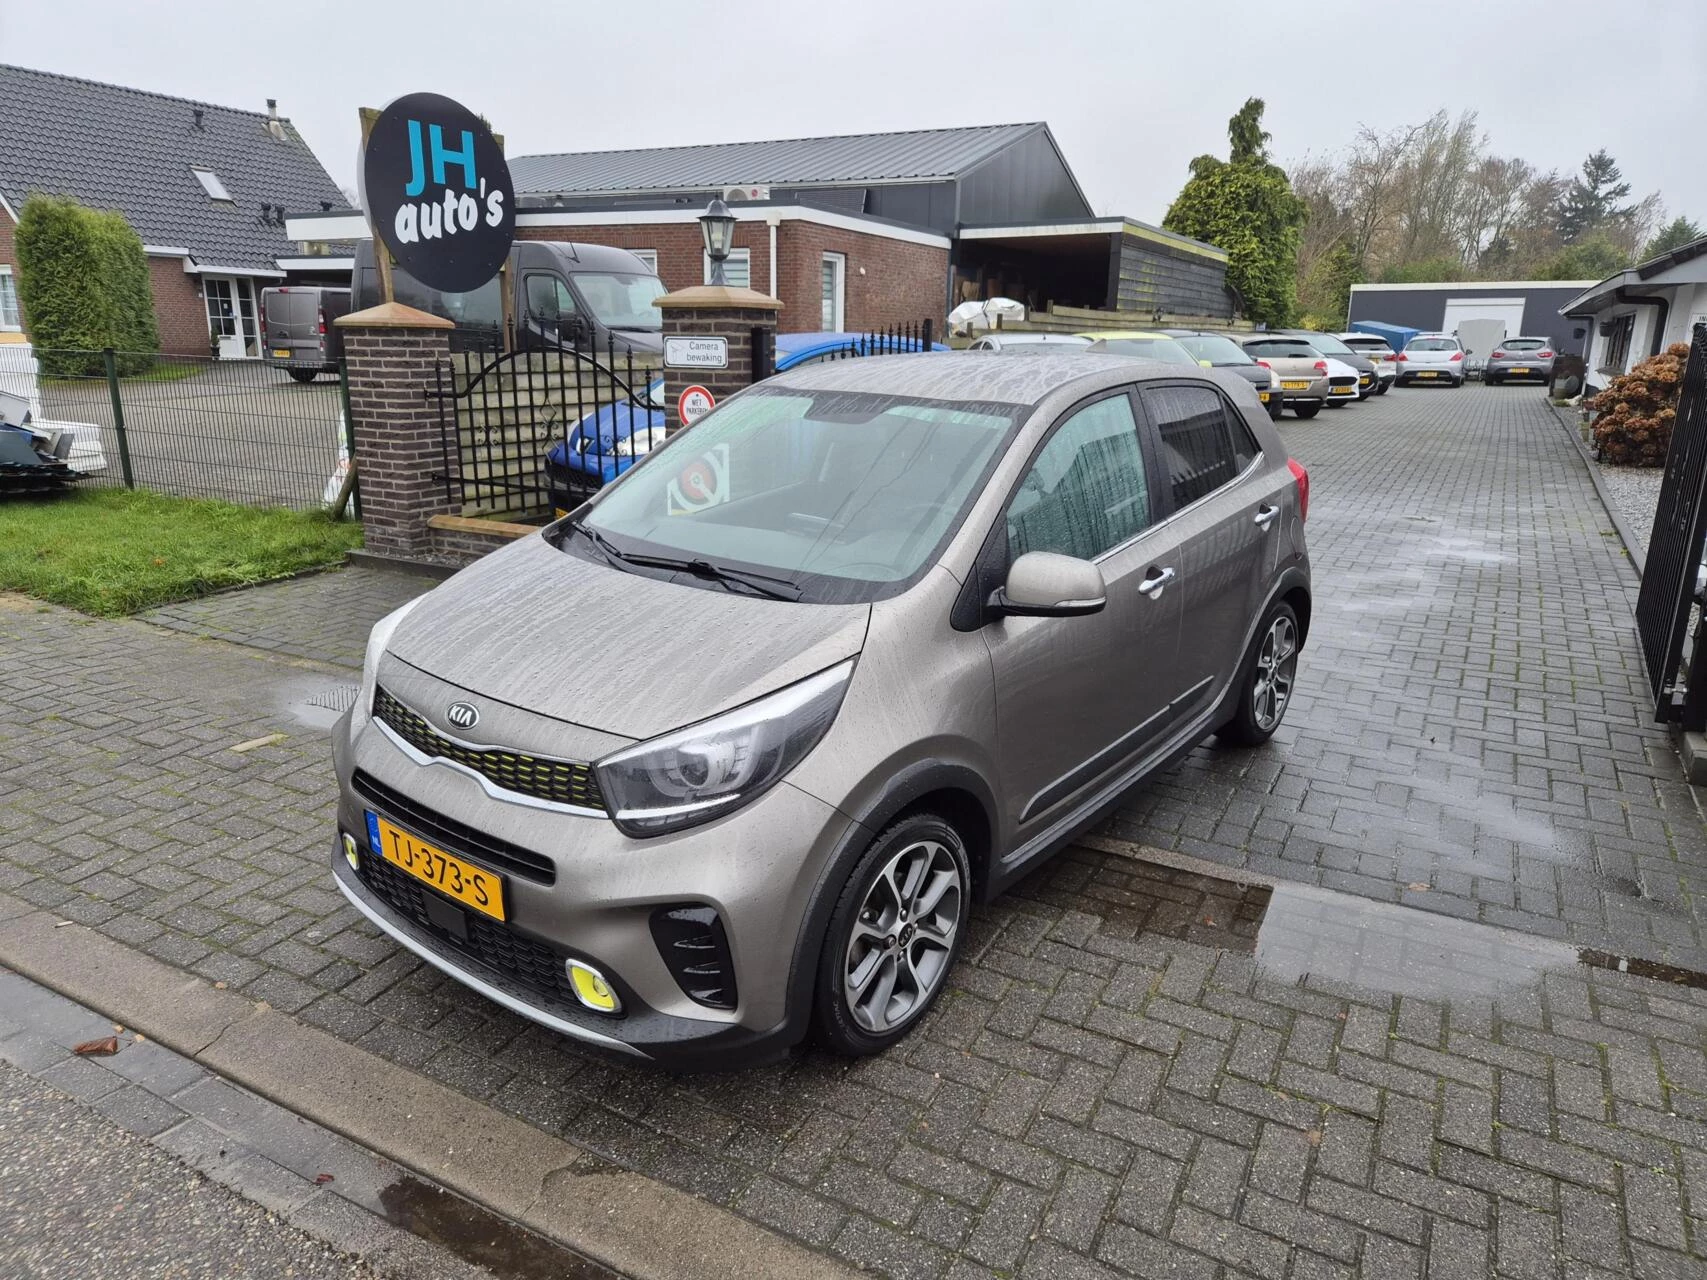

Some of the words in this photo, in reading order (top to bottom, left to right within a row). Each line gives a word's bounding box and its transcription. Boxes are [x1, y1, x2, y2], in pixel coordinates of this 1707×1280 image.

[405, 119, 477, 196] JH
[395, 177, 504, 244] auto's
[686, 353, 722, 363] bewaking
[689, 341, 719, 351] Camera
[449, 705, 472, 726] KIA
[389, 829, 489, 906] TJ-373-S
